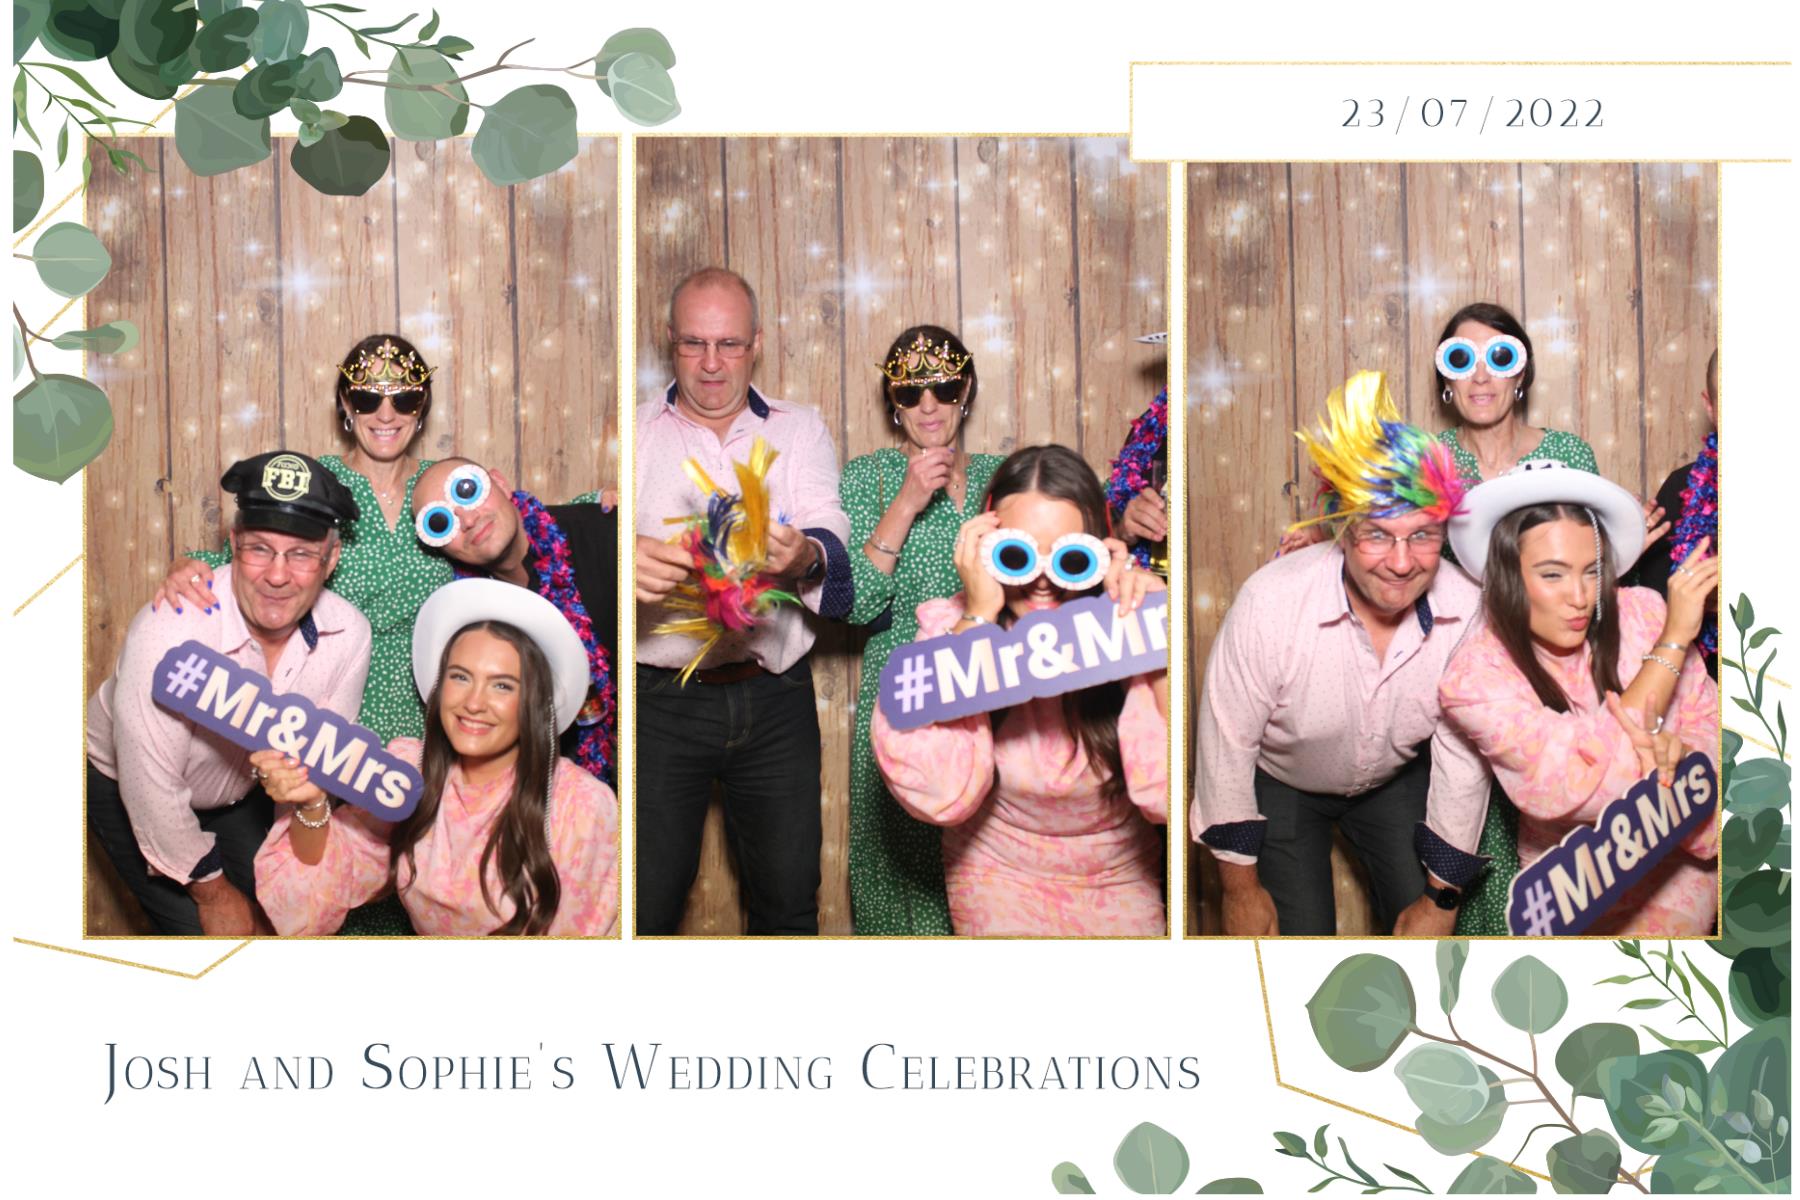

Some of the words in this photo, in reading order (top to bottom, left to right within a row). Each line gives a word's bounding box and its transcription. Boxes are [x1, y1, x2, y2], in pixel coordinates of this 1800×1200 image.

[262, 465, 311, 493] FBI
[166, 653, 411, 808] #Mr&Mrs
[1522, 764, 1711, 936] #Mr&Mrs
